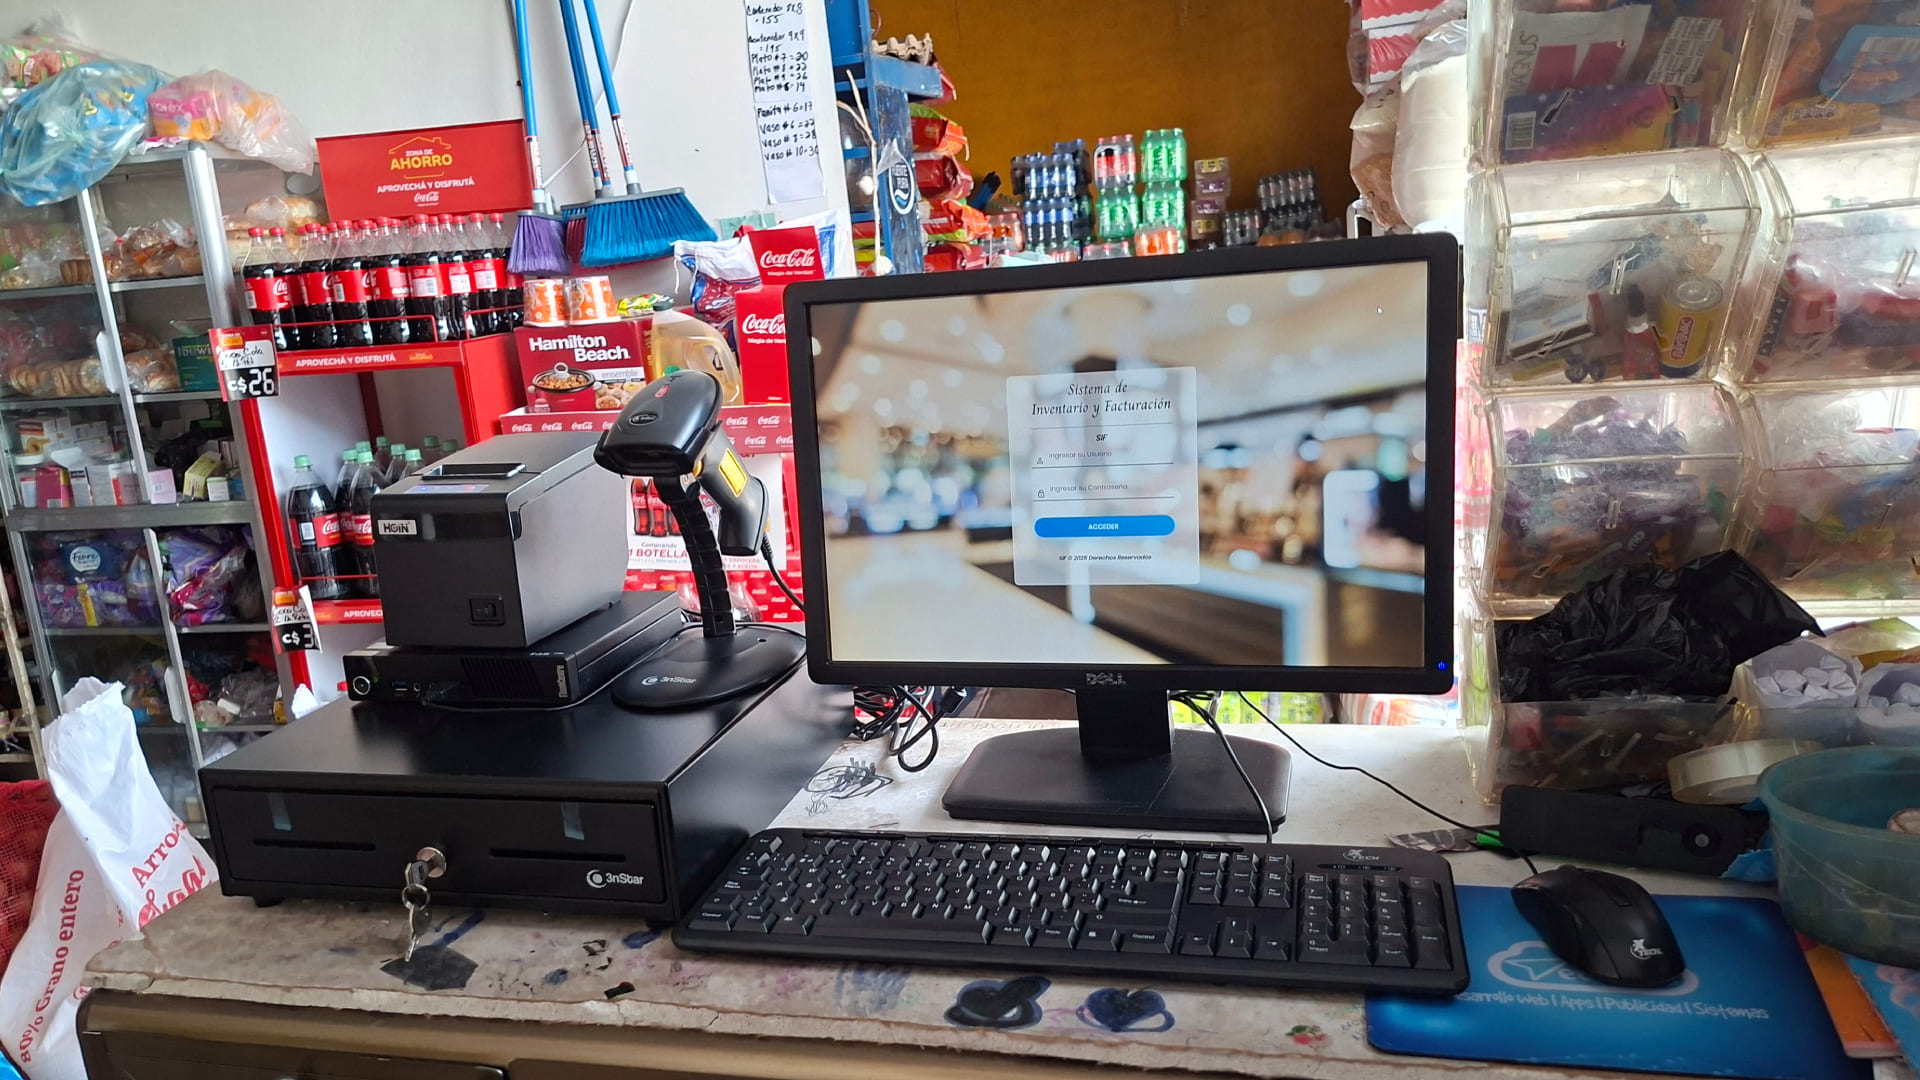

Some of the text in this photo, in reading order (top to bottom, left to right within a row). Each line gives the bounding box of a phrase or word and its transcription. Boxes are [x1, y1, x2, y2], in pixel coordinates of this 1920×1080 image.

[391, 154, 453, 170] AHORRO
[377, 181, 427, 193] APROVECHÁ
[434, 176, 475, 189] DISFRUTÁ
[529, 335, 607, 352] Hamilton
[296, 355, 347, 367] APROVECHÁ
[355, 353, 396, 365] DISFRUTÁ
[574, 346, 630, 362] Beach
[249, 368, 275, 396] 26
[602, 370, 639, 378] ensemble
[1067, 379, 1128, 396] Sistema de
[1031, 397, 1171, 418] Inventario y Facturación
[1087, 450, 1112, 458] Usuario
[1086, 672, 1127, 685] DELL
[605, 872, 644, 885] 3nStar
[36, 946, 69, 1013] Grano
[59, 870, 84, 941] entero
[1455, 992, 1513, 1004] esarrollo
[1561, 994, 1595, 1011] Apps
[1601, 997, 1684, 1014] Publicidad
[1693, 1002, 1770, 1020] Sistemas
